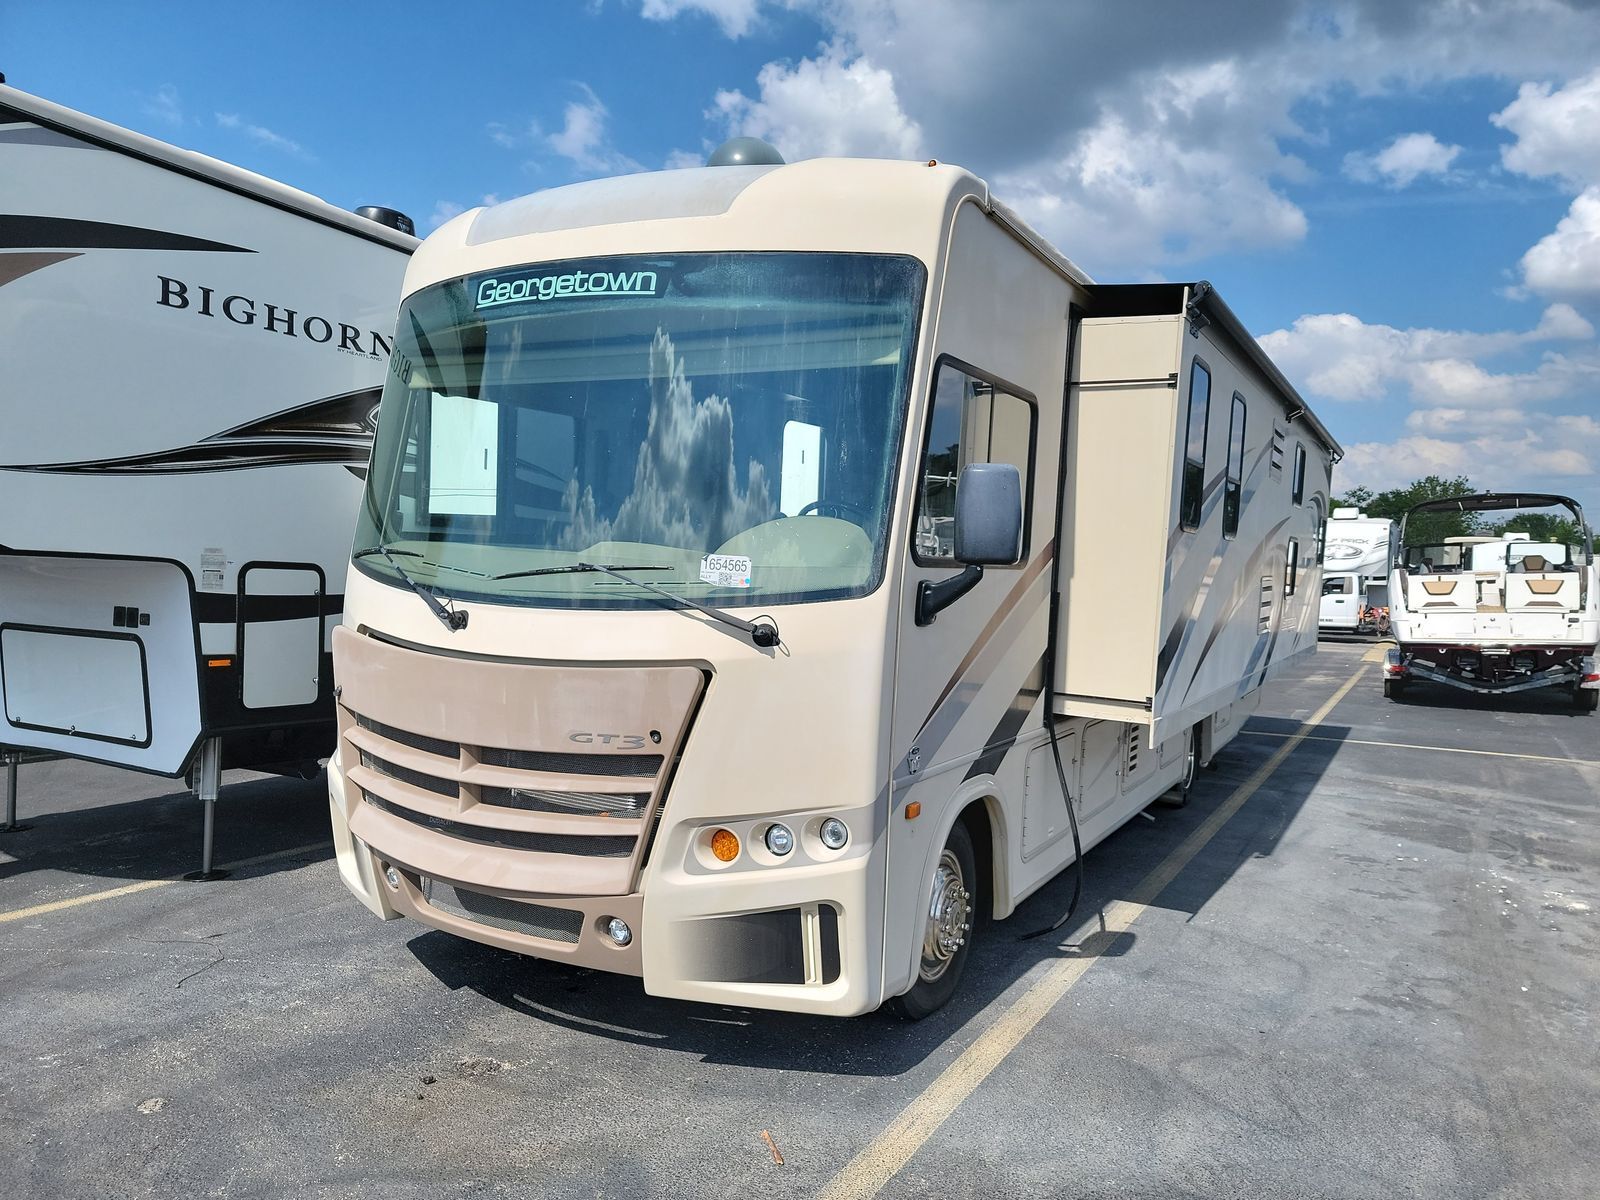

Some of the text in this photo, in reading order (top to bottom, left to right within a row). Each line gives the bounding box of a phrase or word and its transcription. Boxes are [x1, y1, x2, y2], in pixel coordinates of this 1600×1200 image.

[477, 271, 657, 305] Georgetown
[157, 275, 394, 357] BIGHORN
[346, 350, 383, 362] HEARTLAND
[704, 558, 748, 573] 1654565
[569, 733, 646, 750] GT3
